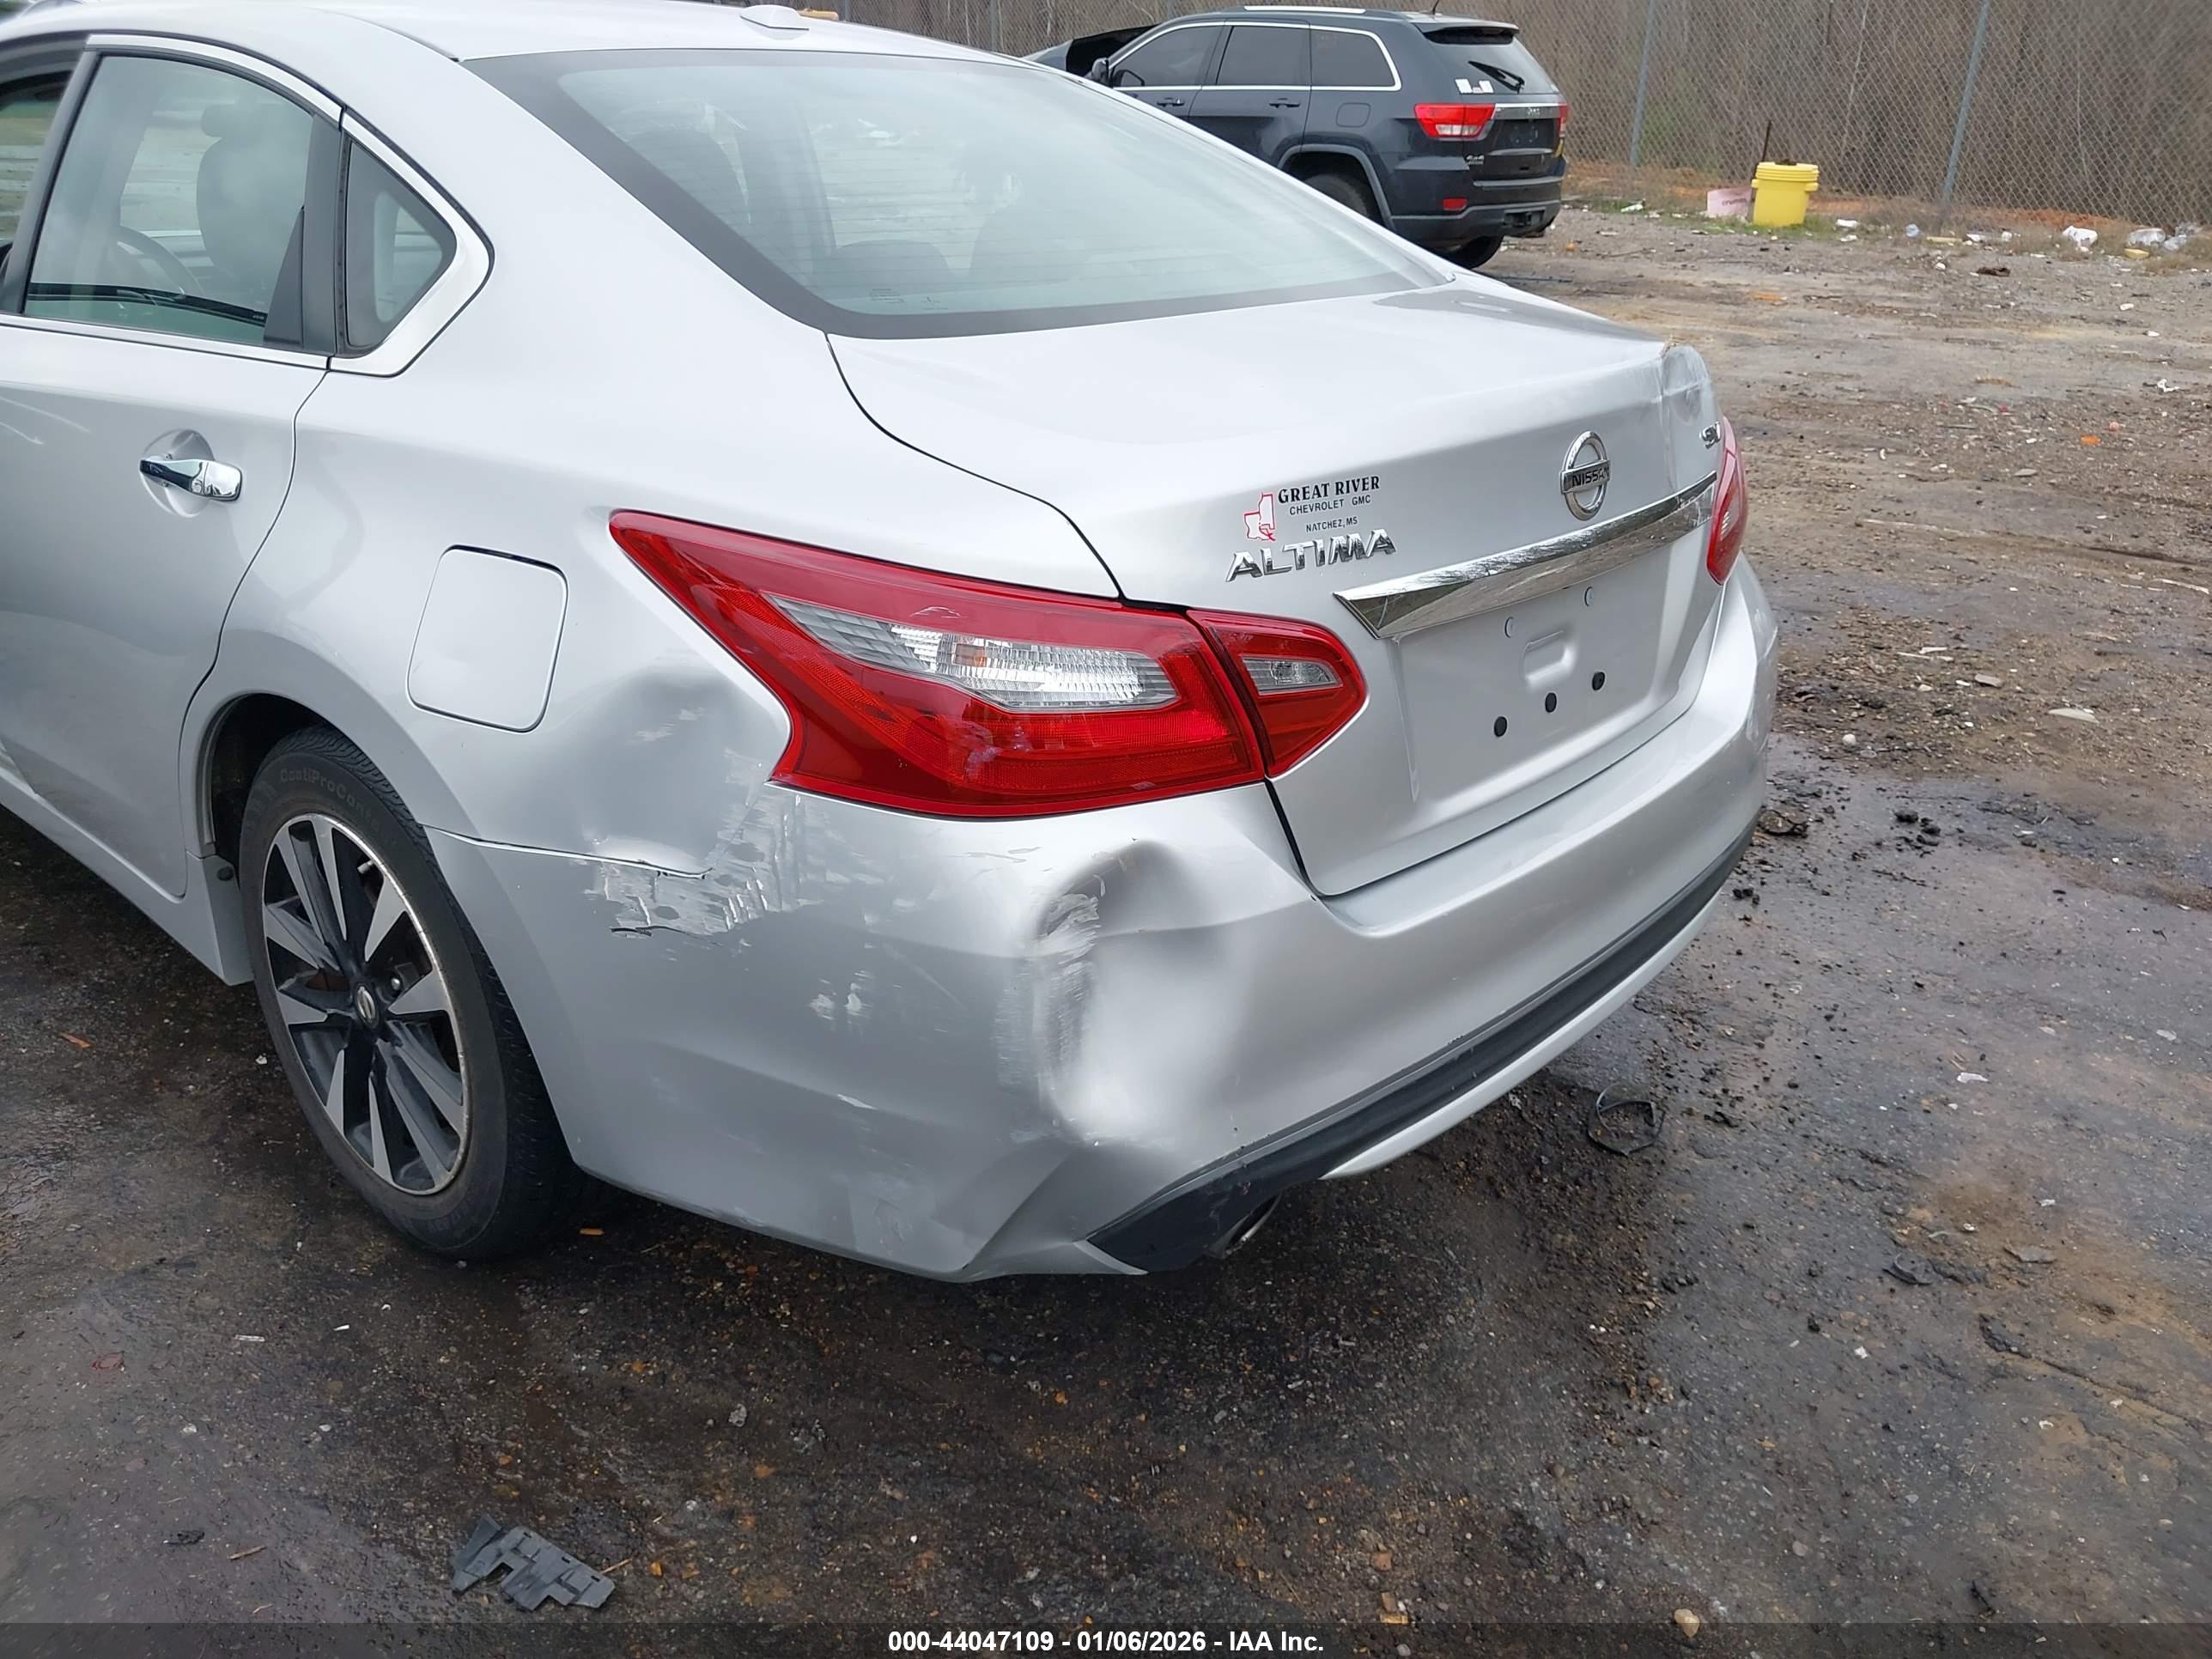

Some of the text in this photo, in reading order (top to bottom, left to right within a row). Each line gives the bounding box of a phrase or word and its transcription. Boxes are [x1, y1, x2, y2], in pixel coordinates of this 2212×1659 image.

[1572, 466, 1609, 486] NISSAN
[1278, 476, 1380, 504] GREAT RIVER
[1290, 494, 1371, 515] CHEVROLET GMC
[1225, 528, 1396, 582] ALTIMA
